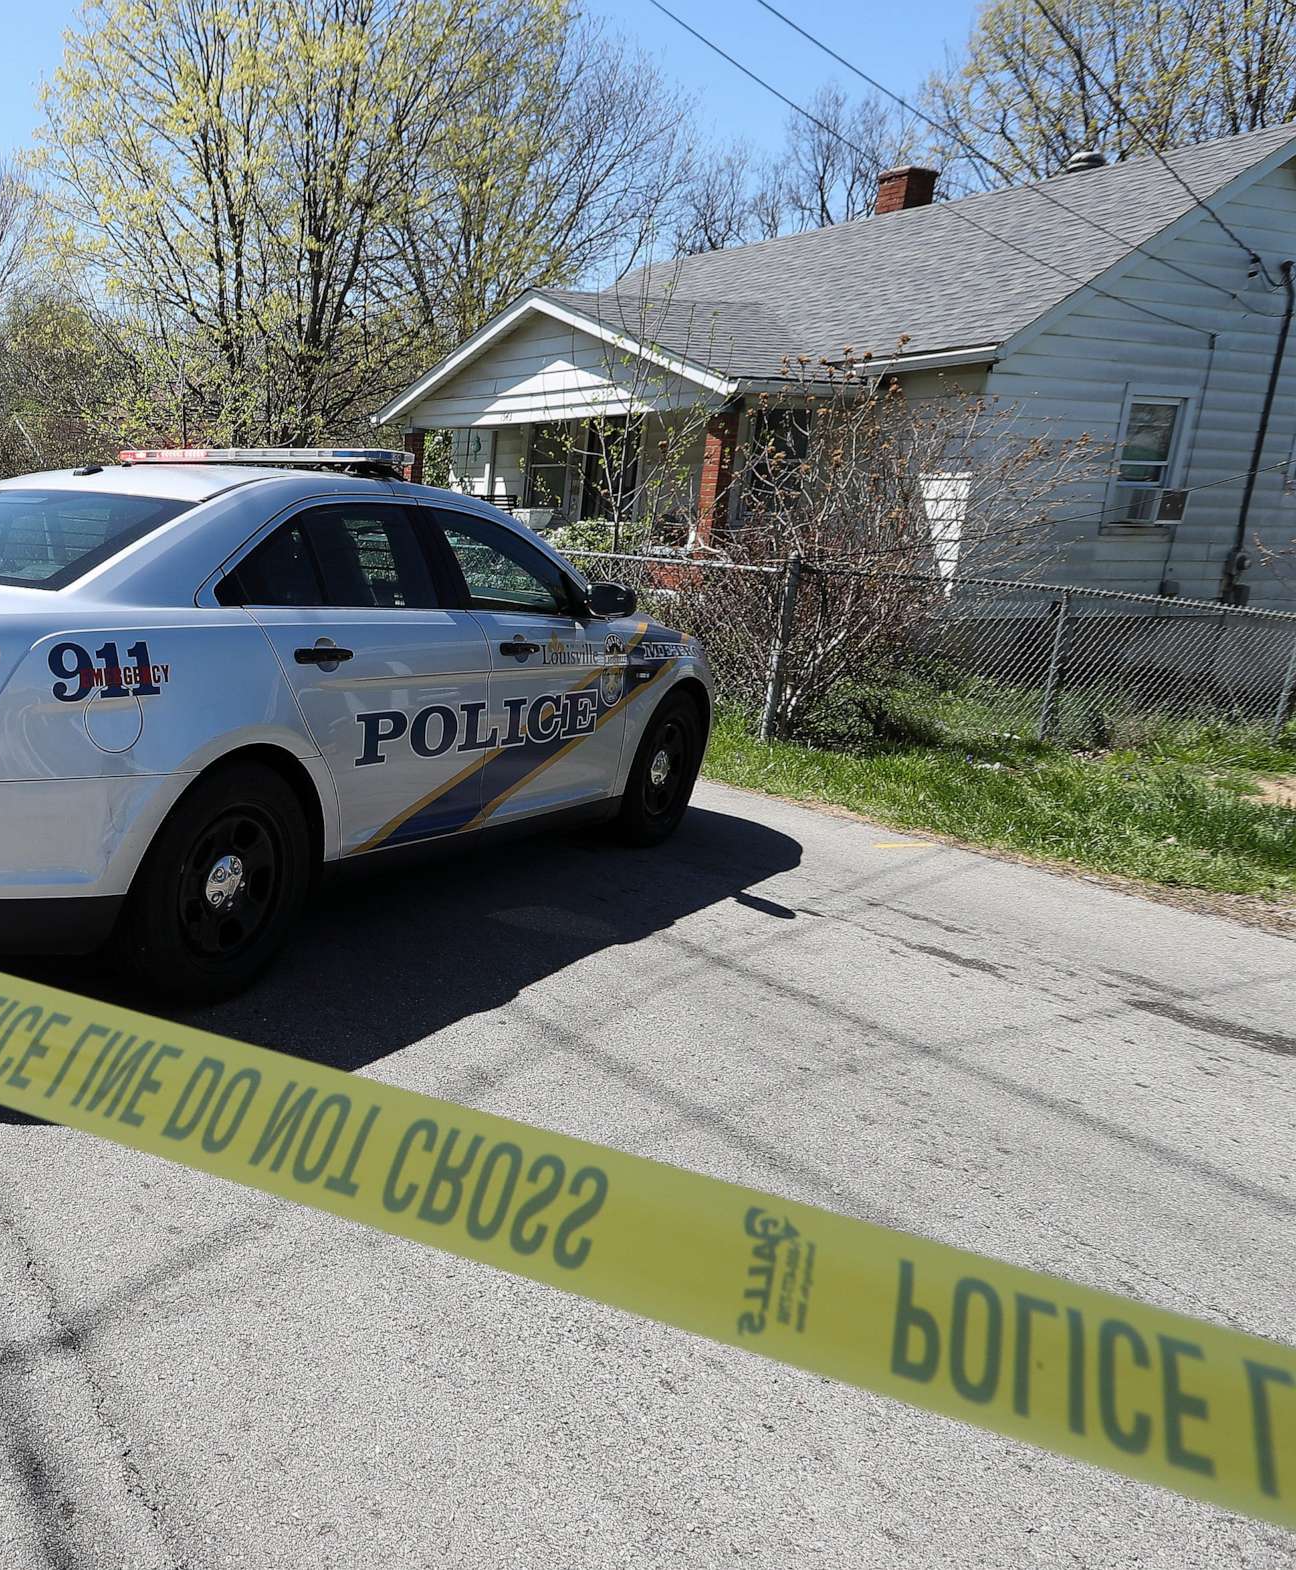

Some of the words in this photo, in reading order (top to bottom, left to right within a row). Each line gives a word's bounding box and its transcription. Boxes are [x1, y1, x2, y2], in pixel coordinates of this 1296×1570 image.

[47, 640, 161, 704] 911
[542, 644, 598, 665] Louisville
[353, 689, 600, 769] POLICE
